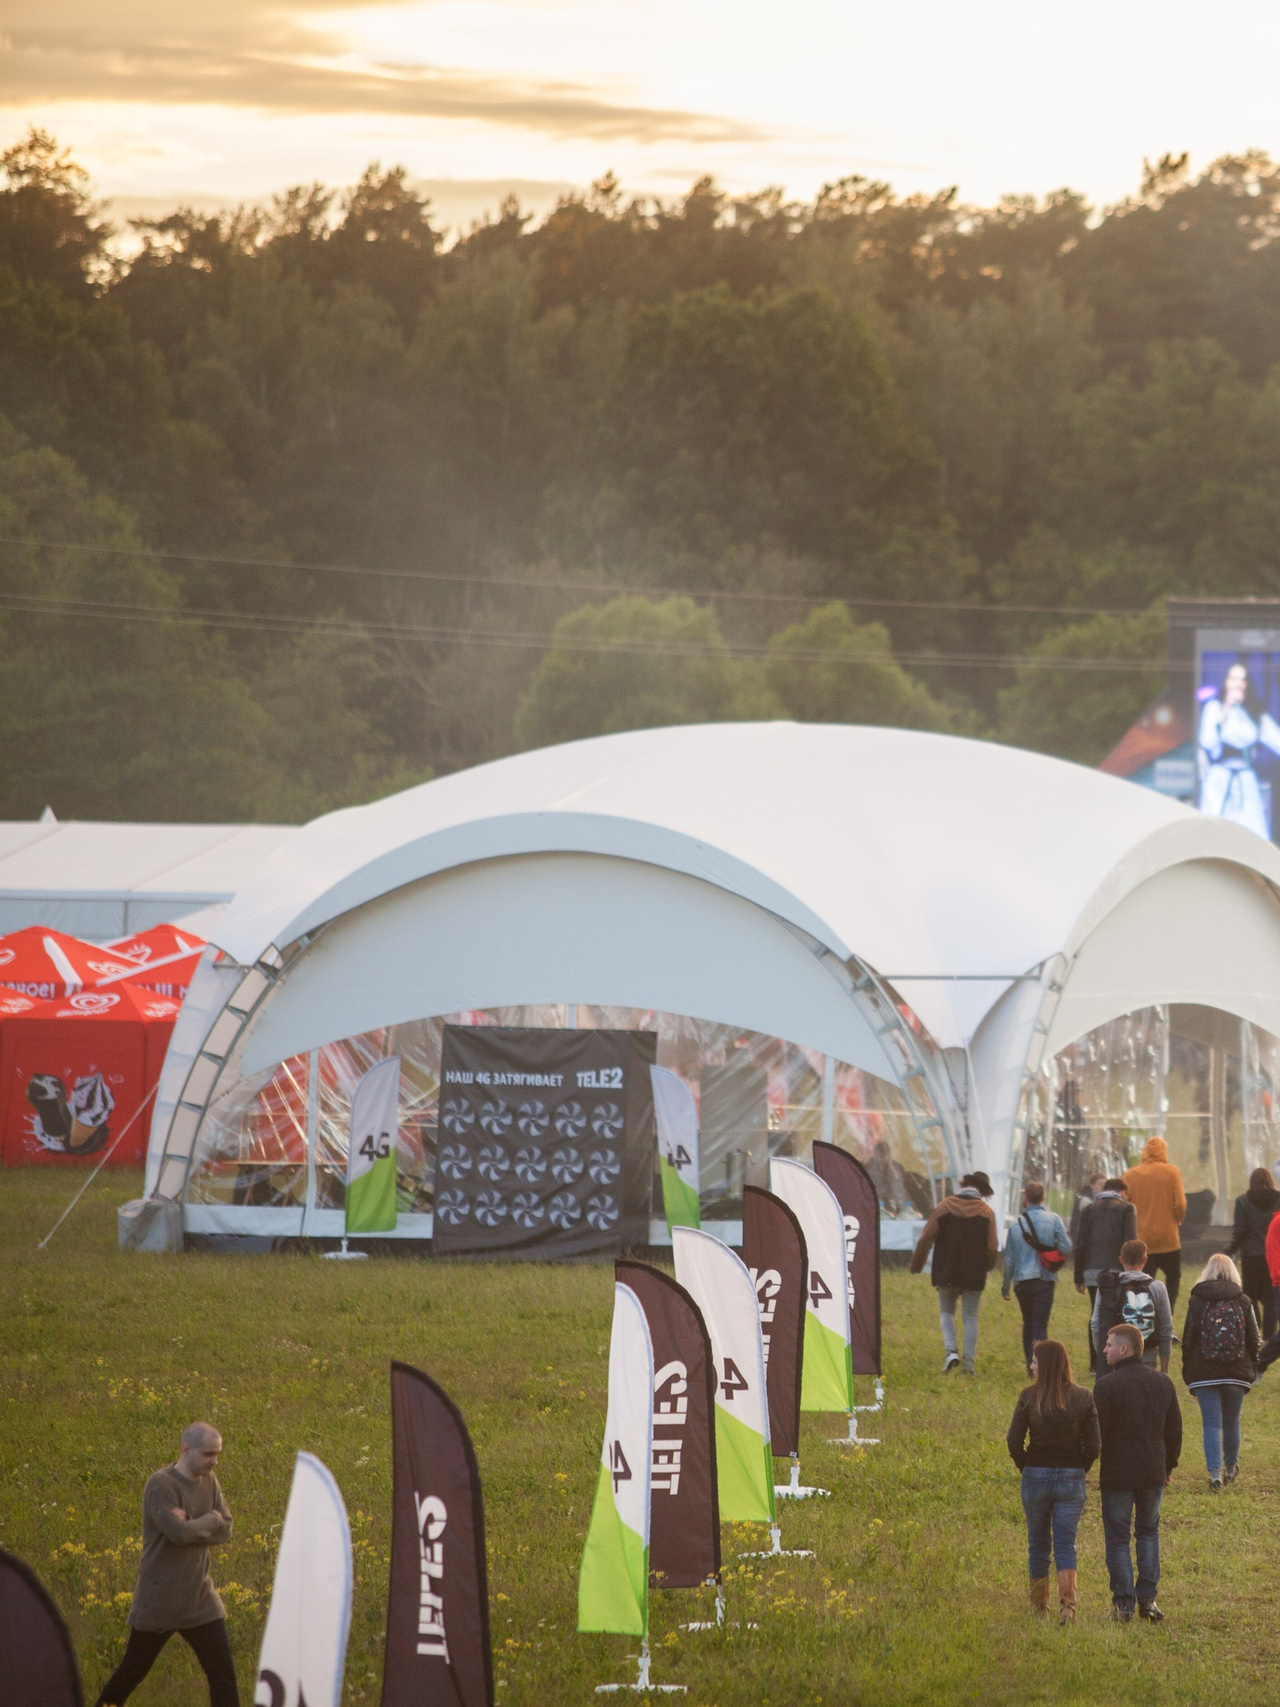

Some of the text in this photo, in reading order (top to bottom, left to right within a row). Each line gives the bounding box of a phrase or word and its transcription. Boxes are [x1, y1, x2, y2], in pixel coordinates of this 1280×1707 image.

[446, 1070, 564, 1087] НАШ 4G ЗАТЯГИВАЕТ
[576, 1067, 623, 1088] TELE2
[359, 1132, 390, 1162] 4G
